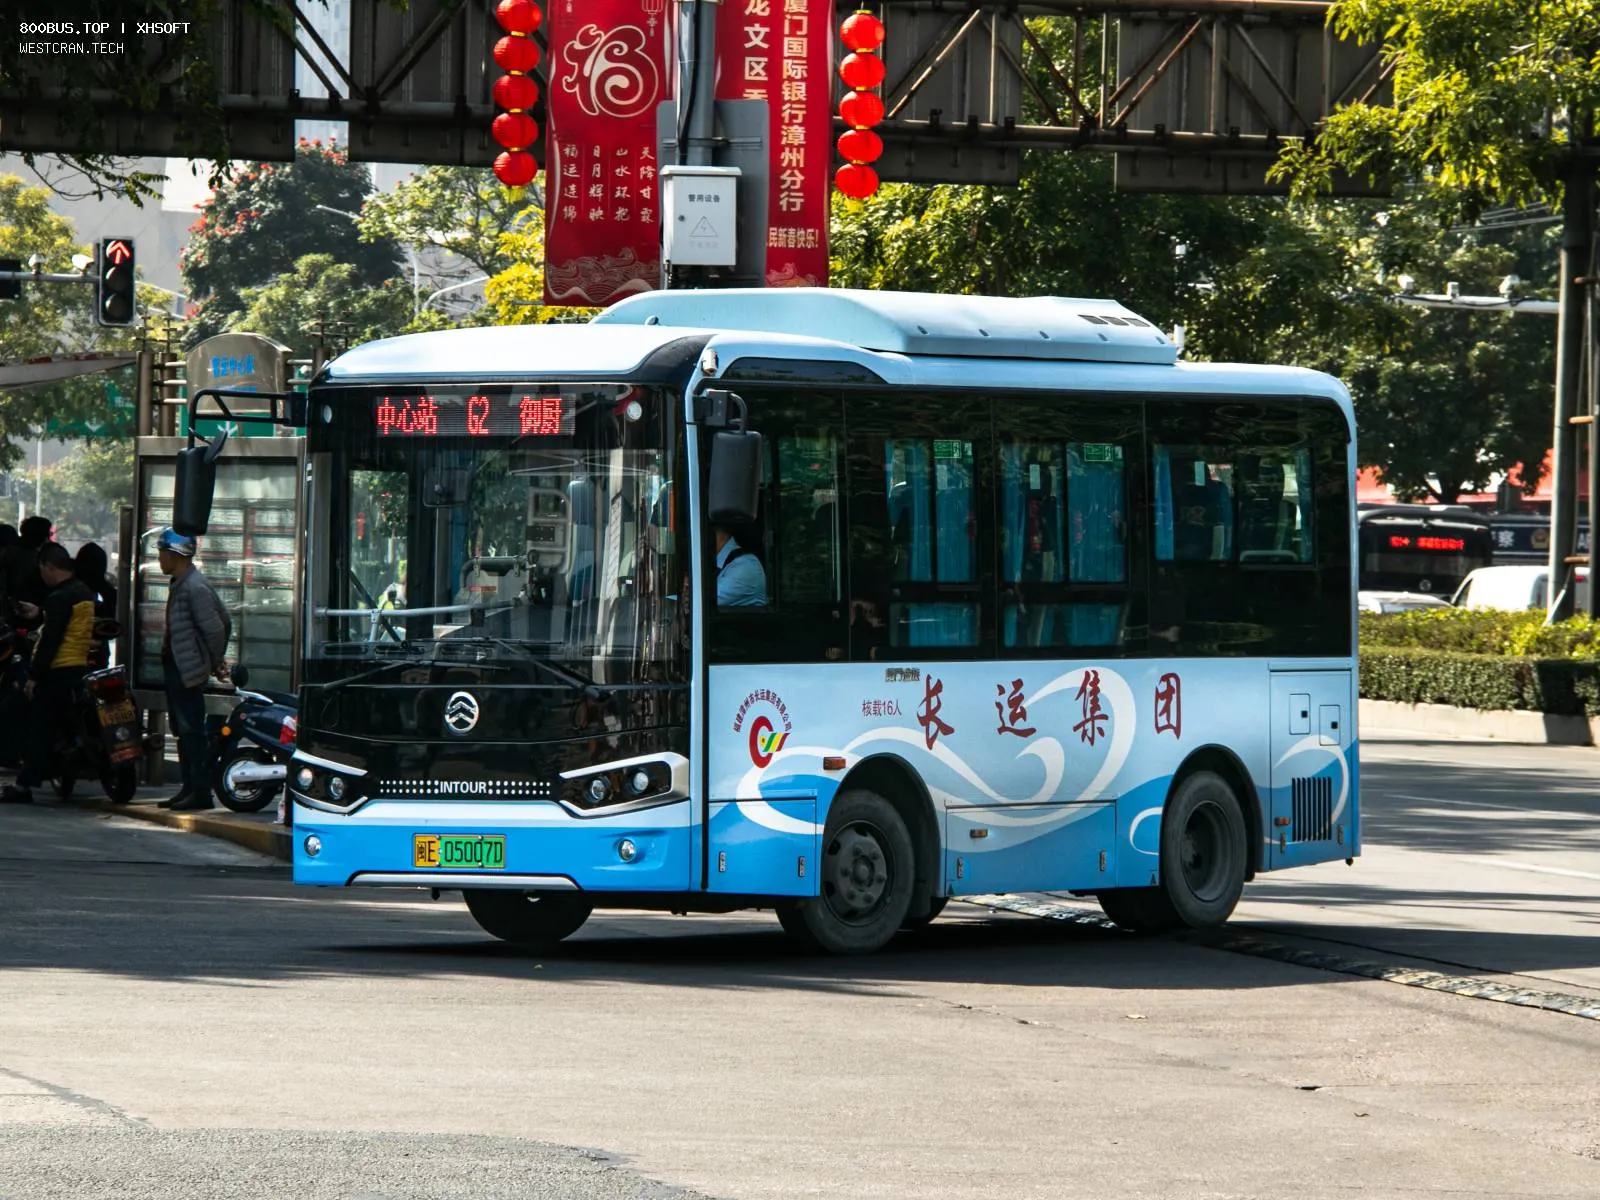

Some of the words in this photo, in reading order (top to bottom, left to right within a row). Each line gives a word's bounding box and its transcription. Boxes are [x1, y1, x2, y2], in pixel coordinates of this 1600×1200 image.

[742, 0, 771, 100] 龙文区
[377, 396, 439, 435] 中心站
[916, 668, 1183, 751] 长运集团
[440, 780, 487, 794] INTOUR
